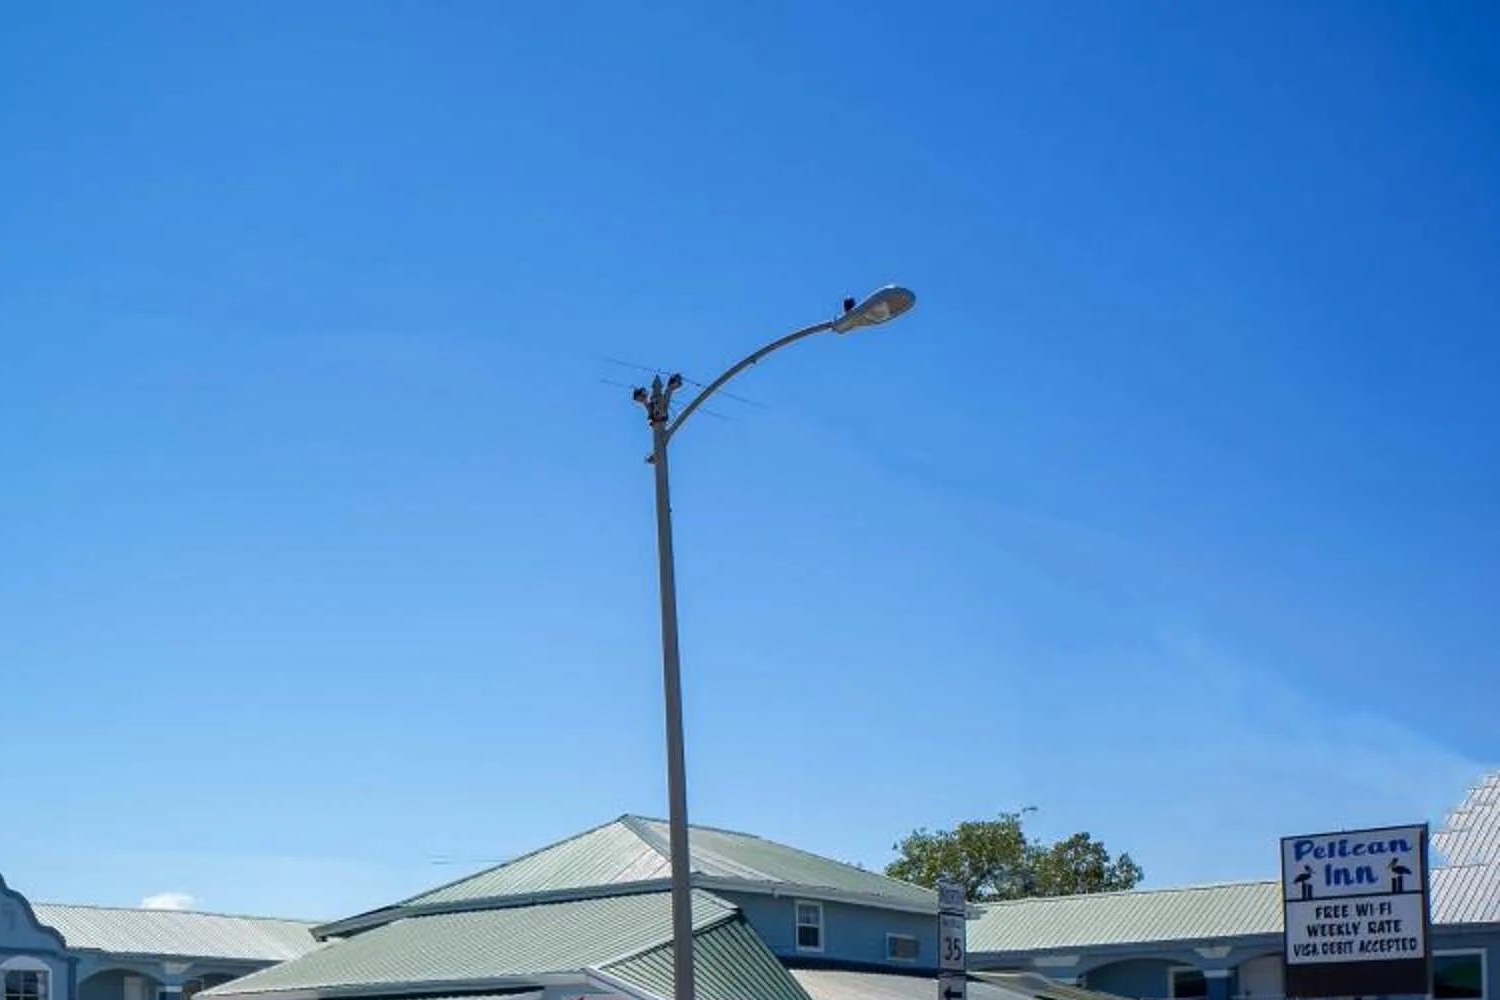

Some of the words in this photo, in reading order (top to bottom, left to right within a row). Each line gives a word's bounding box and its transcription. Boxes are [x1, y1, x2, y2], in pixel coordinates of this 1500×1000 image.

[1294, 838, 1412, 861] Pelican
[1325, 863, 1378, 886] Inn
[1315, 905, 1349, 920] FREE
[1307, 921, 1361, 938] WEEKLY
[1367, 919, 1402, 935] RATE
[944, 937, 962, 961] 35
[1359, 937, 1417, 954] ACCEPTED
